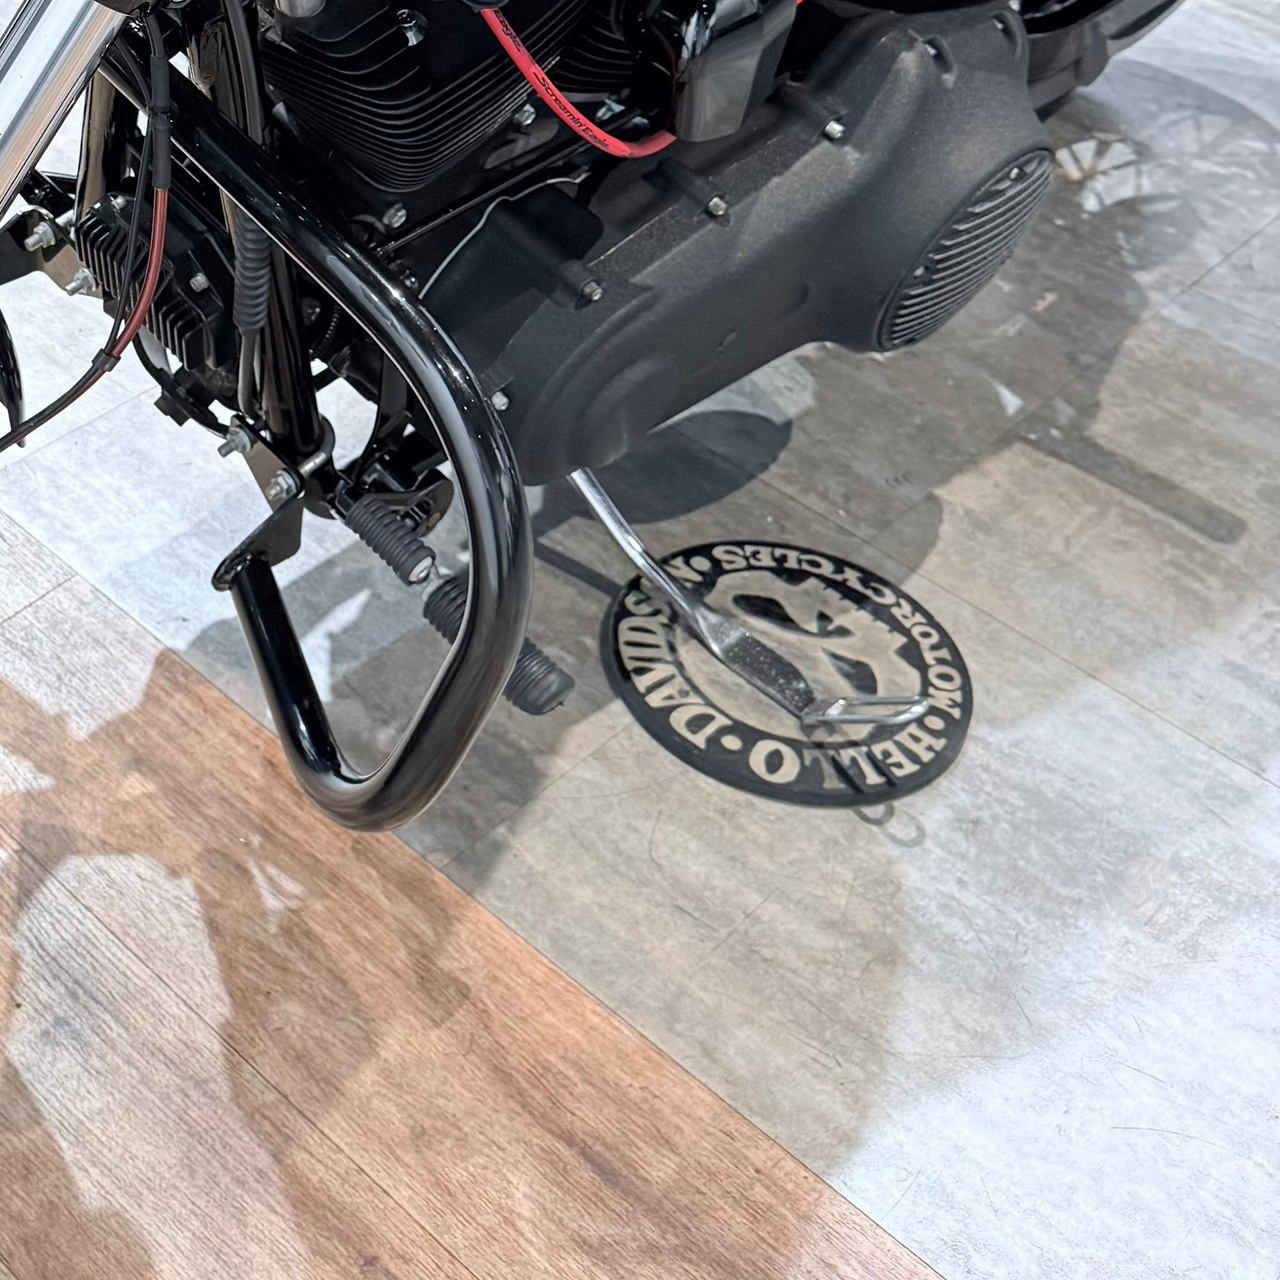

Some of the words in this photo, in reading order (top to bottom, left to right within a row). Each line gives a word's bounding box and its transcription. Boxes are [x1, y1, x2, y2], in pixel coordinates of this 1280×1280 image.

[618, 554, 730, 752] DAVIDSN
[711, 544, 962, 722] MOTORCYCLES
[748, 726, 948, 791] HELLO
